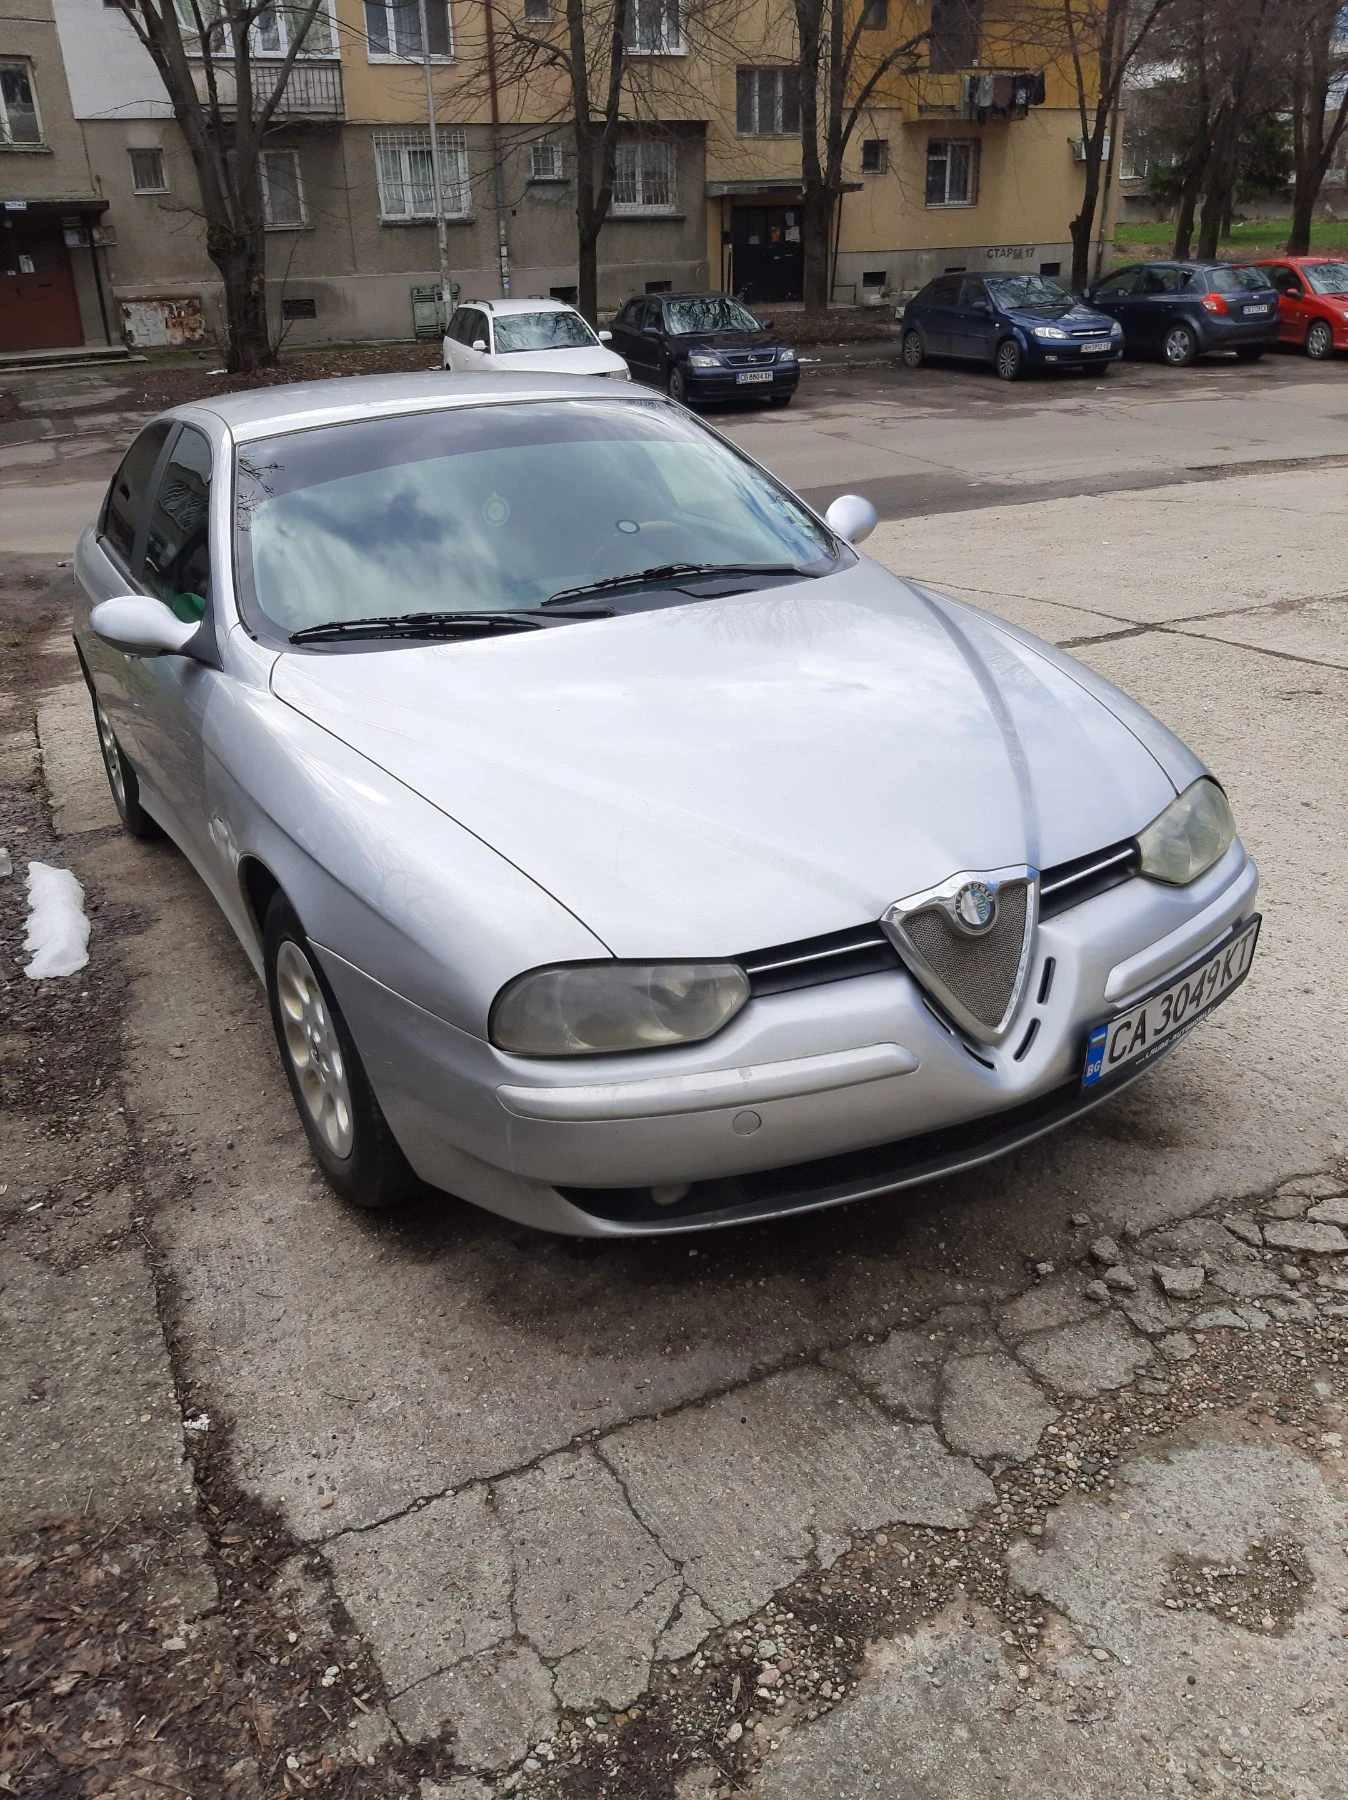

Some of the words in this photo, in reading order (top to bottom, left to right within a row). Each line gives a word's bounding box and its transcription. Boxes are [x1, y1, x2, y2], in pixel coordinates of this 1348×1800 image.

[1108, 1009, 1146, 1064] CA
[1153, 959, 1220, 1037] 3049
[1086, 1060, 1101, 1077] BG
